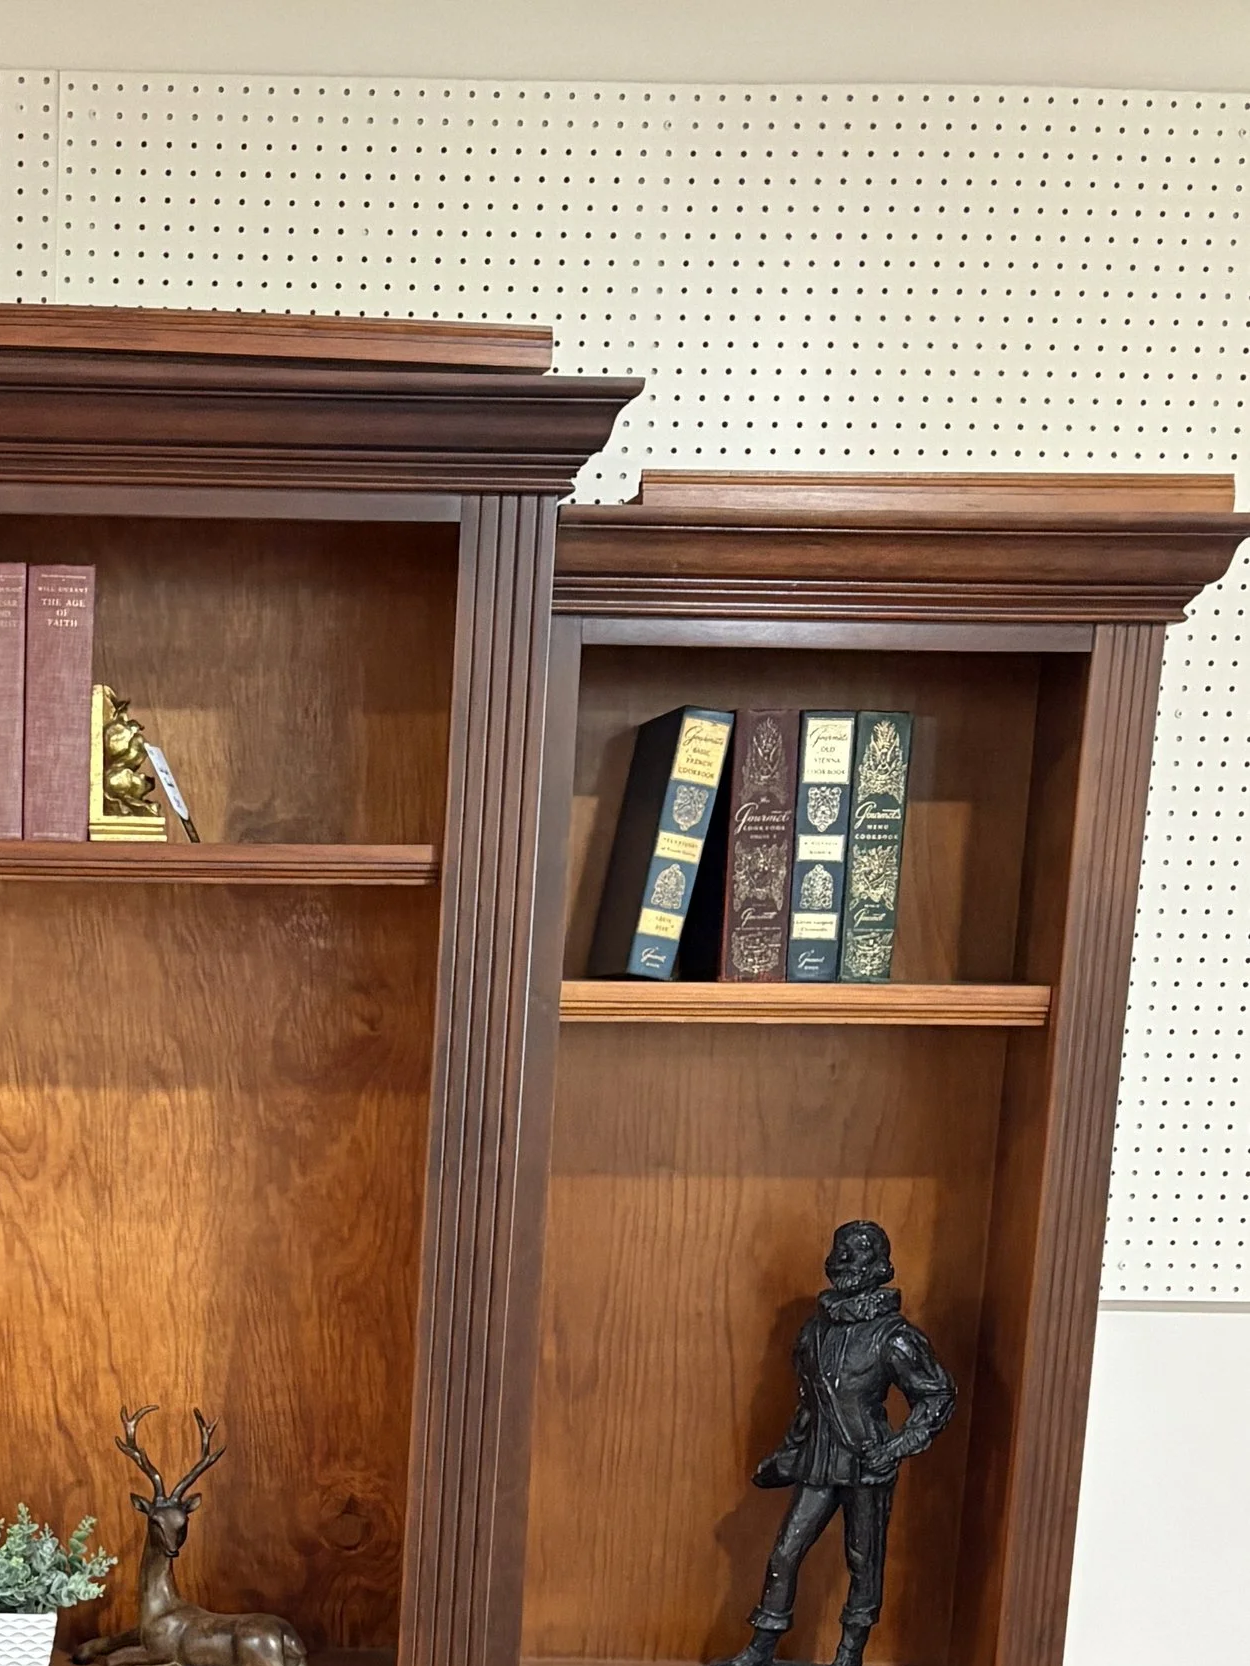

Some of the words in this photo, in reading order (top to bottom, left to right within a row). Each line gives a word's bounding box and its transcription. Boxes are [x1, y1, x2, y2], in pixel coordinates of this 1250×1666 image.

[41, 598, 62, 606] THE
[65, 599, 87, 608] AGE
[56, 609, 68, 617] OF
[48, 618, 78, 627] FAITH
